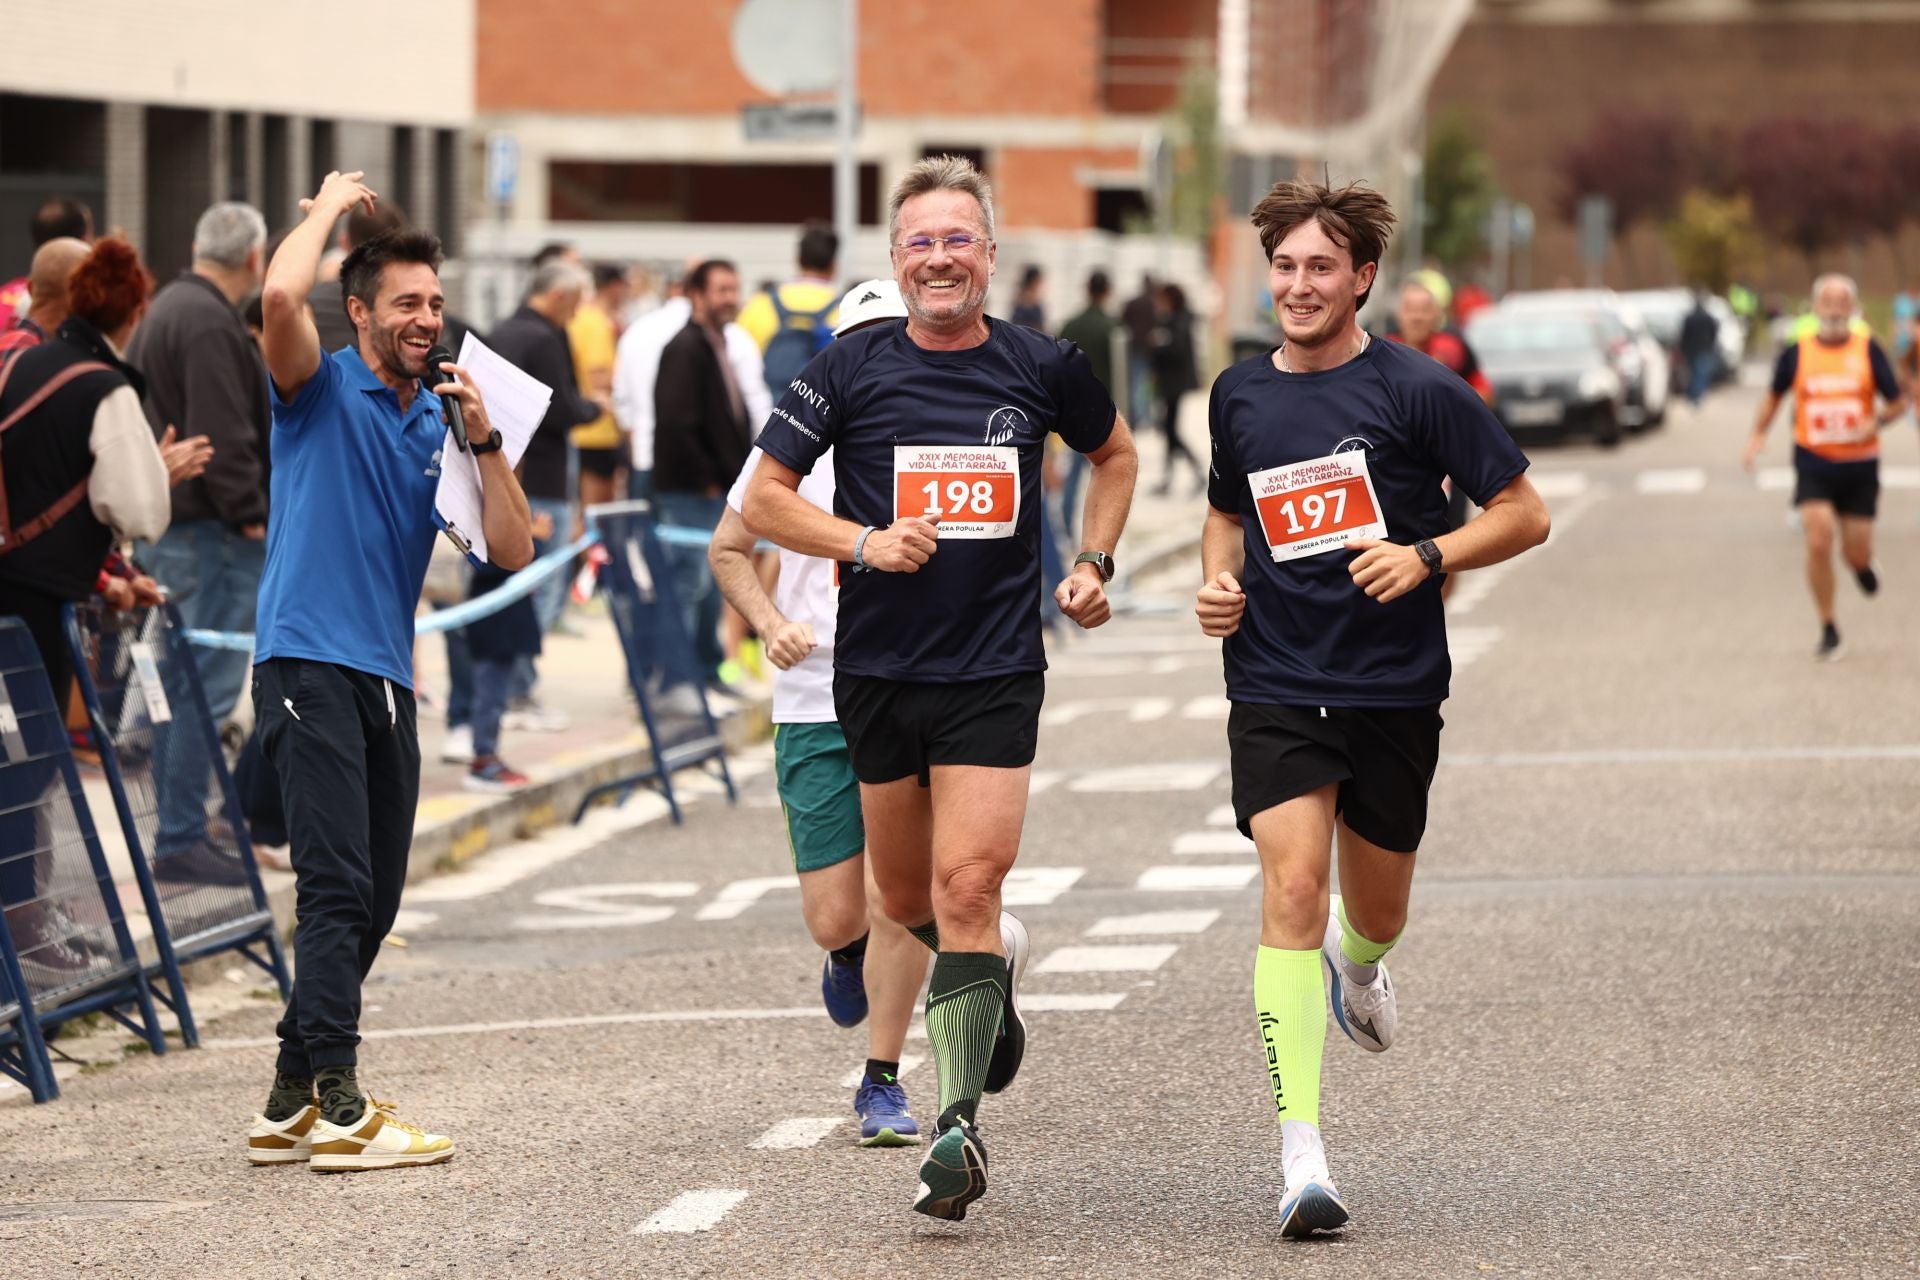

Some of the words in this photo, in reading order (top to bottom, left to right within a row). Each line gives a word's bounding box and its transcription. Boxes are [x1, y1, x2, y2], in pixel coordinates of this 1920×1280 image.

[788, 415, 821, 442] Bomberos
[908, 461, 1007, 470] VIDAL-MATARRANZ
[918, 453, 941, 461] XXIX
[943, 453, 998, 462] MEMORIAL
[1262, 467, 1354, 494] VIDAL-MATARRANZ
[1267, 473, 1289, 485] XXIX
[1291, 462, 1342, 478] MEMORIAL
[922, 480, 994, 514] 198
[1280, 487, 1348, 535] 197
[1292, 541, 1319, 552] CARRERA
[1320, 534, 1349, 545] POPULAR
